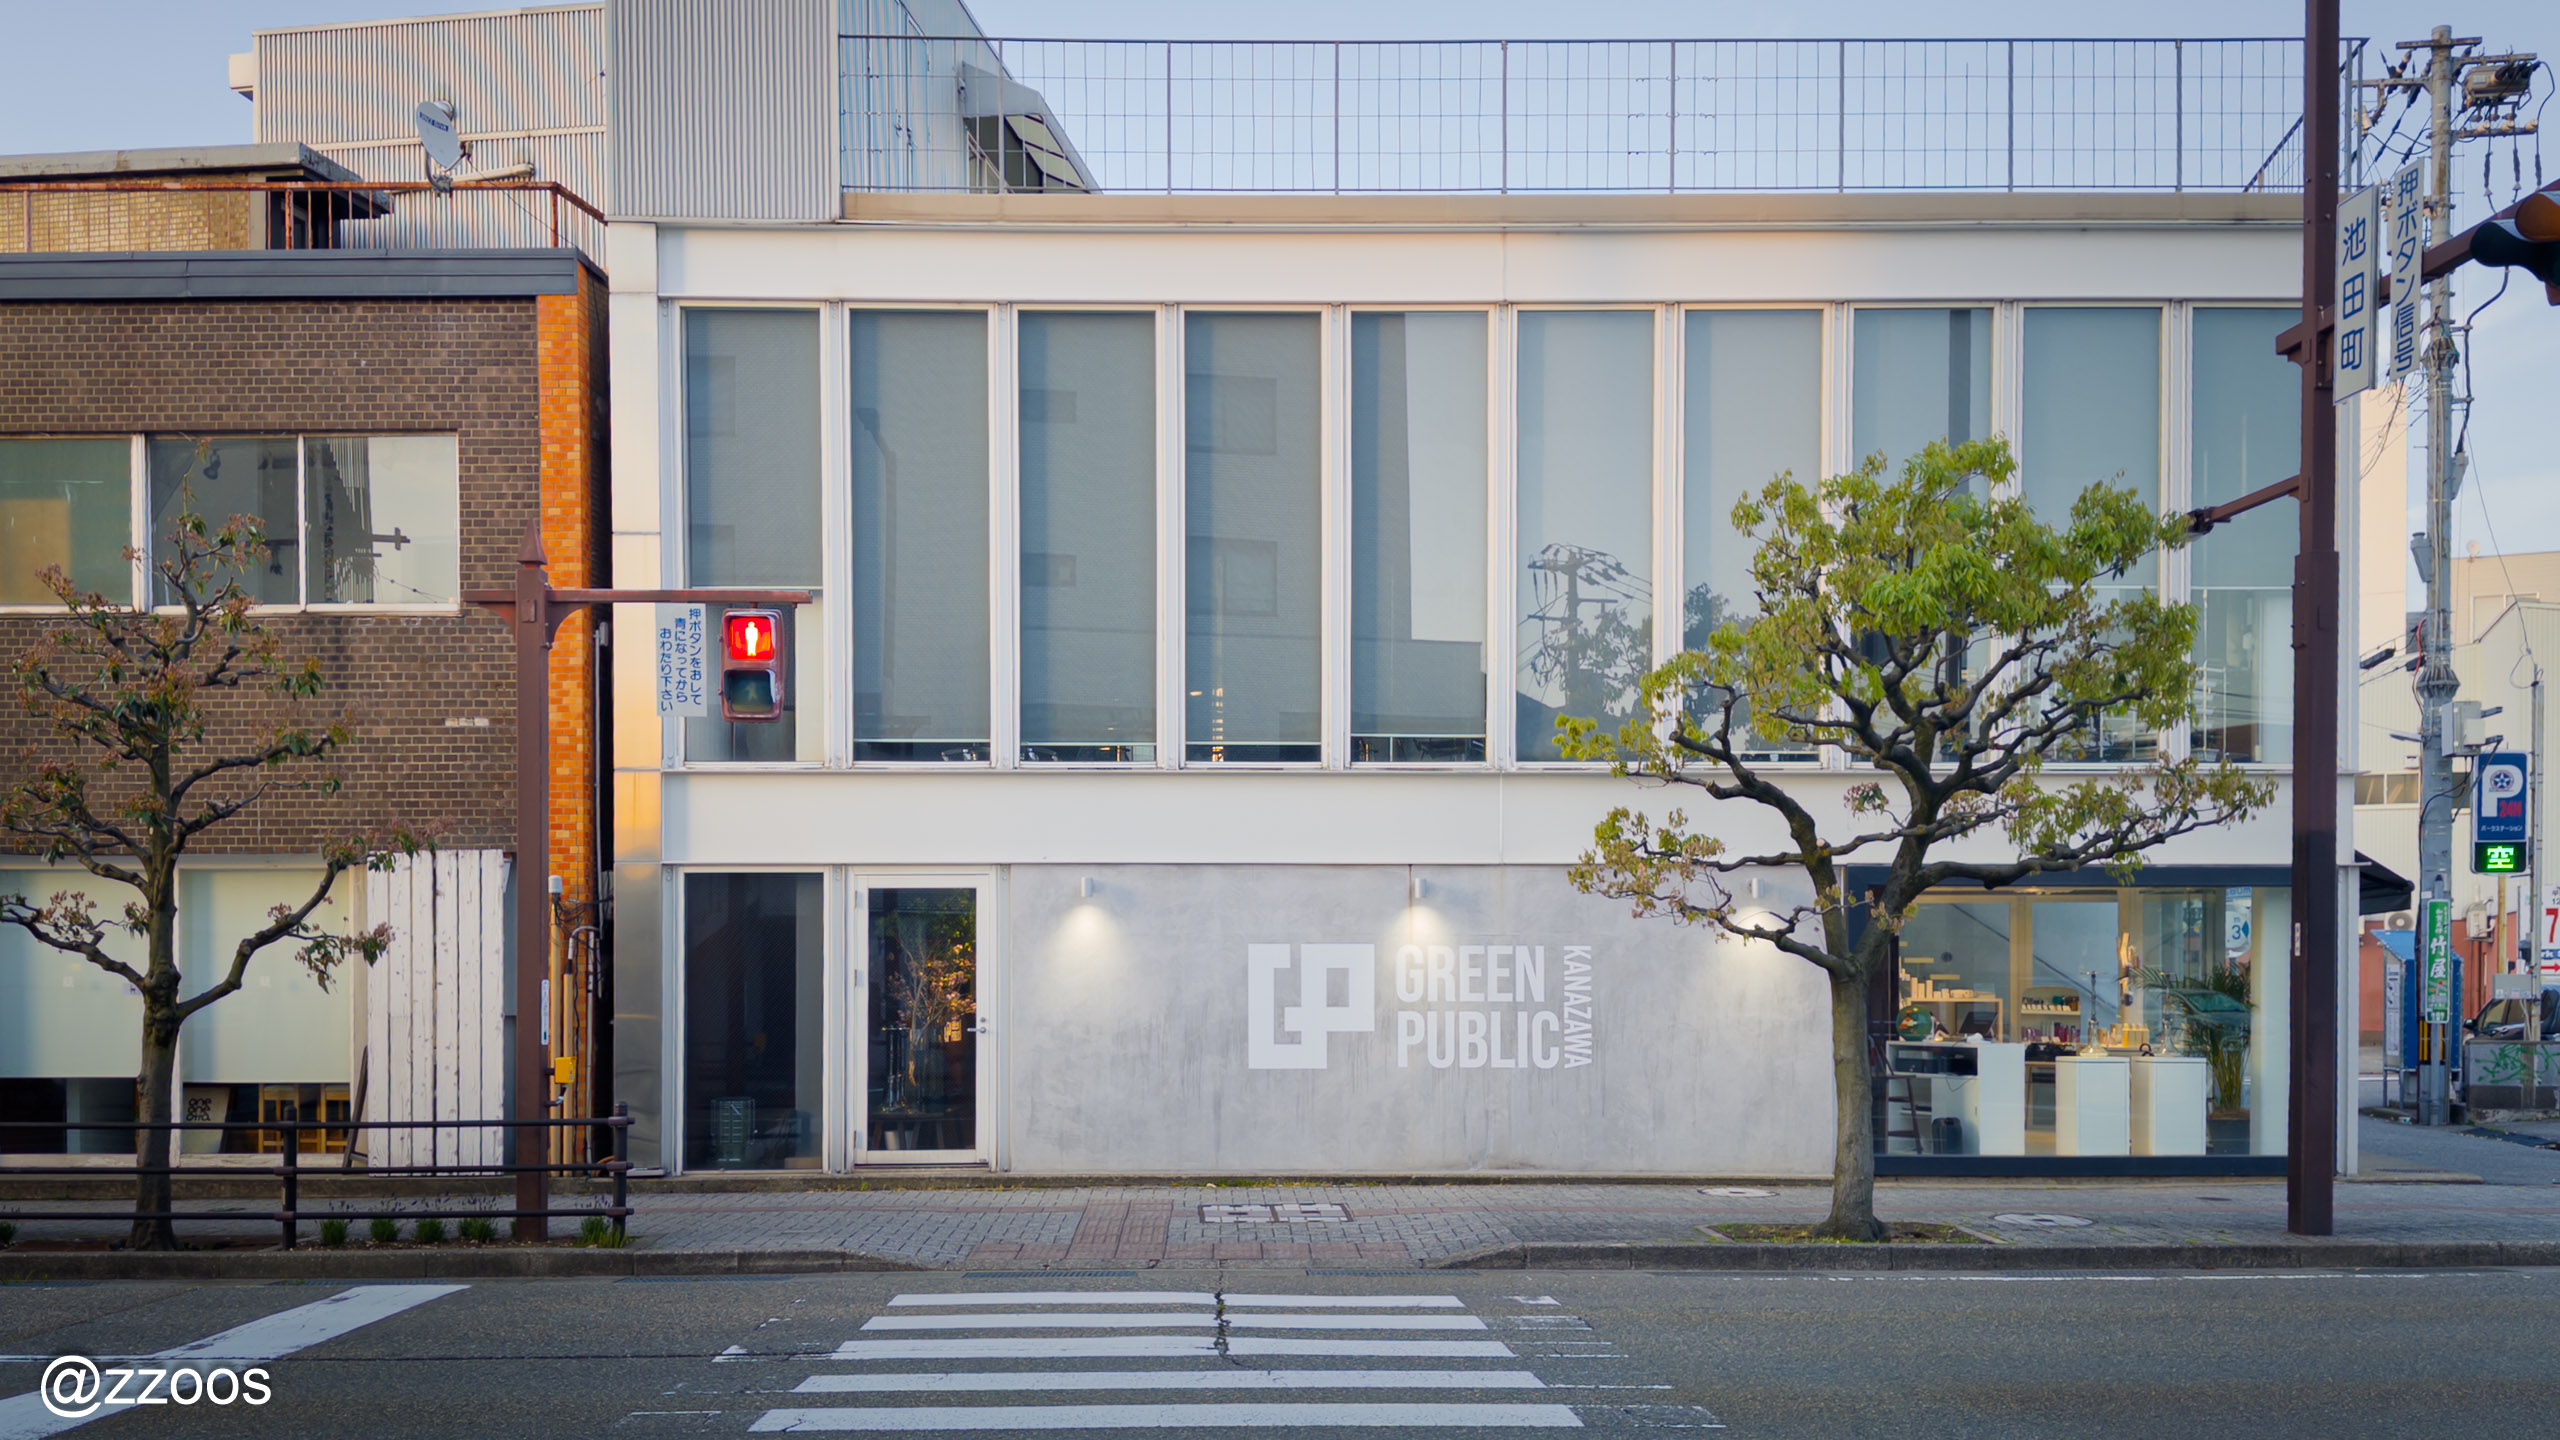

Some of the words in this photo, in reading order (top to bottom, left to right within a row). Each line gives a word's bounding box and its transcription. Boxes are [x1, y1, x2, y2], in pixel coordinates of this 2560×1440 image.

[2340, 216, 2367, 371] 池田町
[2393, 166, 2420, 373] 押ボタン信号
[659, 628, 674, 712] おわたり下さい
[674, 617, 689, 703] 青になってから
[688, 608, 702, 706] 押ボタンをおして
[2481, 764, 2524, 818] P
[2499, 800, 2523, 818] 24H
[2480, 824, 2523, 833] パークステーション
[2486, 845, 2515, 870] 空
[1395, 944, 1545, 1003] GREEN
[2430, 935, 2447, 979] 竹屋
[1563, 945, 1593, 1069] KANAZAWA
[1397, 1010, 1560, 1069] PUBLIC
